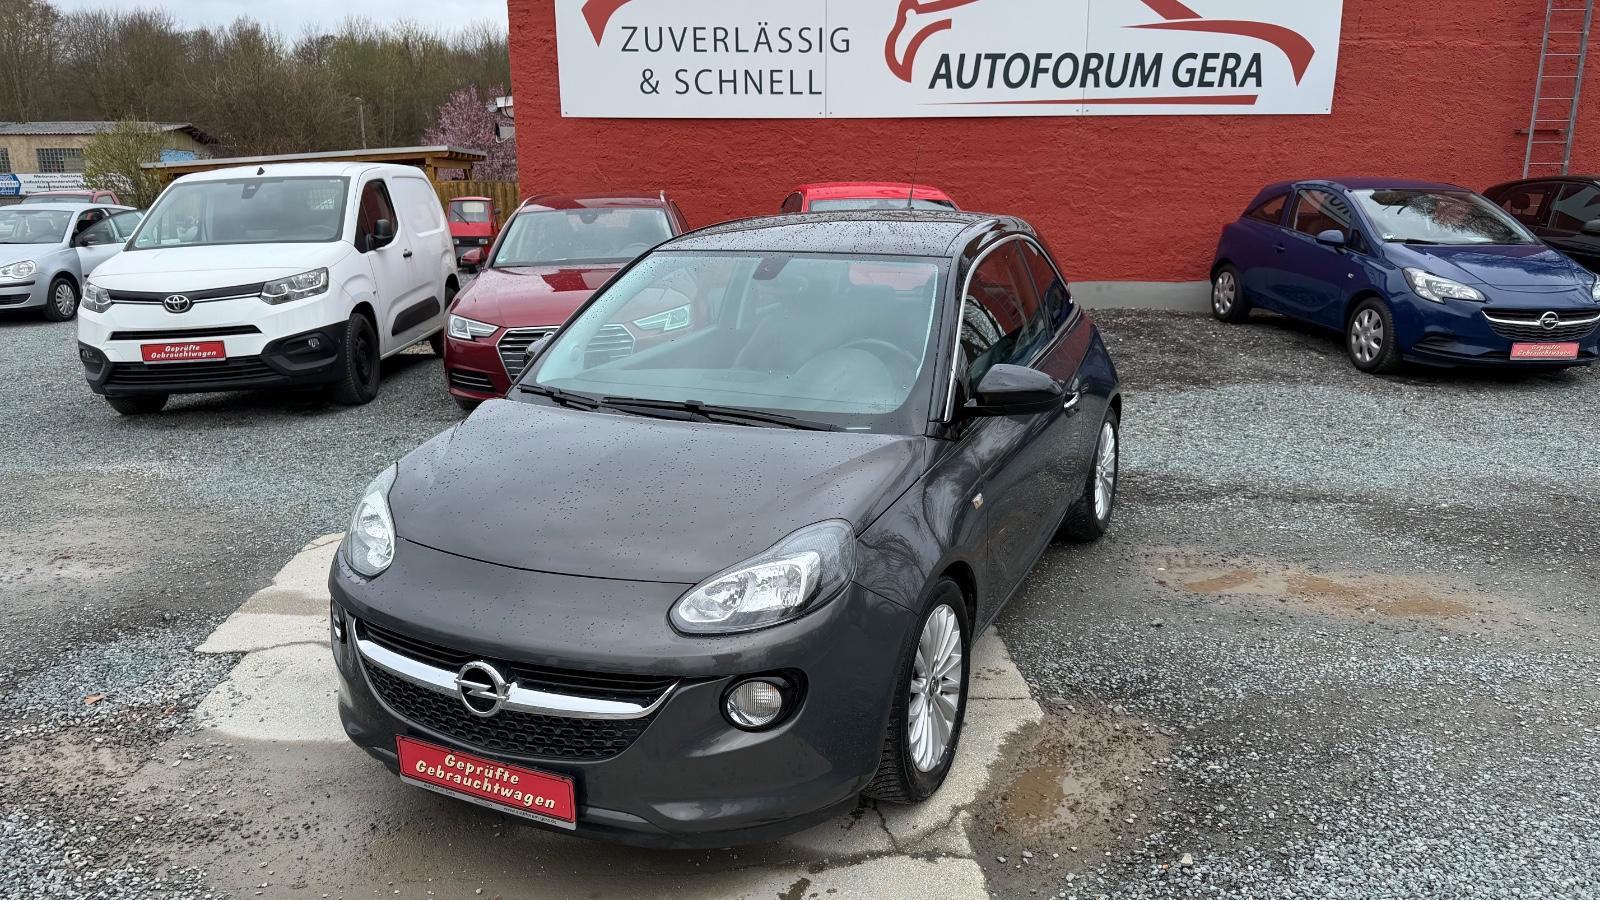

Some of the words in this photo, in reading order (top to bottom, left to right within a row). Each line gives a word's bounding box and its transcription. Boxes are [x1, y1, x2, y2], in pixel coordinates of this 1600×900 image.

[621, 21, 850, 54] ZUVERLÄSSIG
[639, 68, 660, 95] &
[674, 68, 822, 95] SCHNELL
[928, 52, 1164, 90] AUTOFORUM
[1171, 52, 1263, 89] GERA
[414, 759, 556, 808] Gebrauchtwagen
[444, 754, 520, 785] Geprüfte
